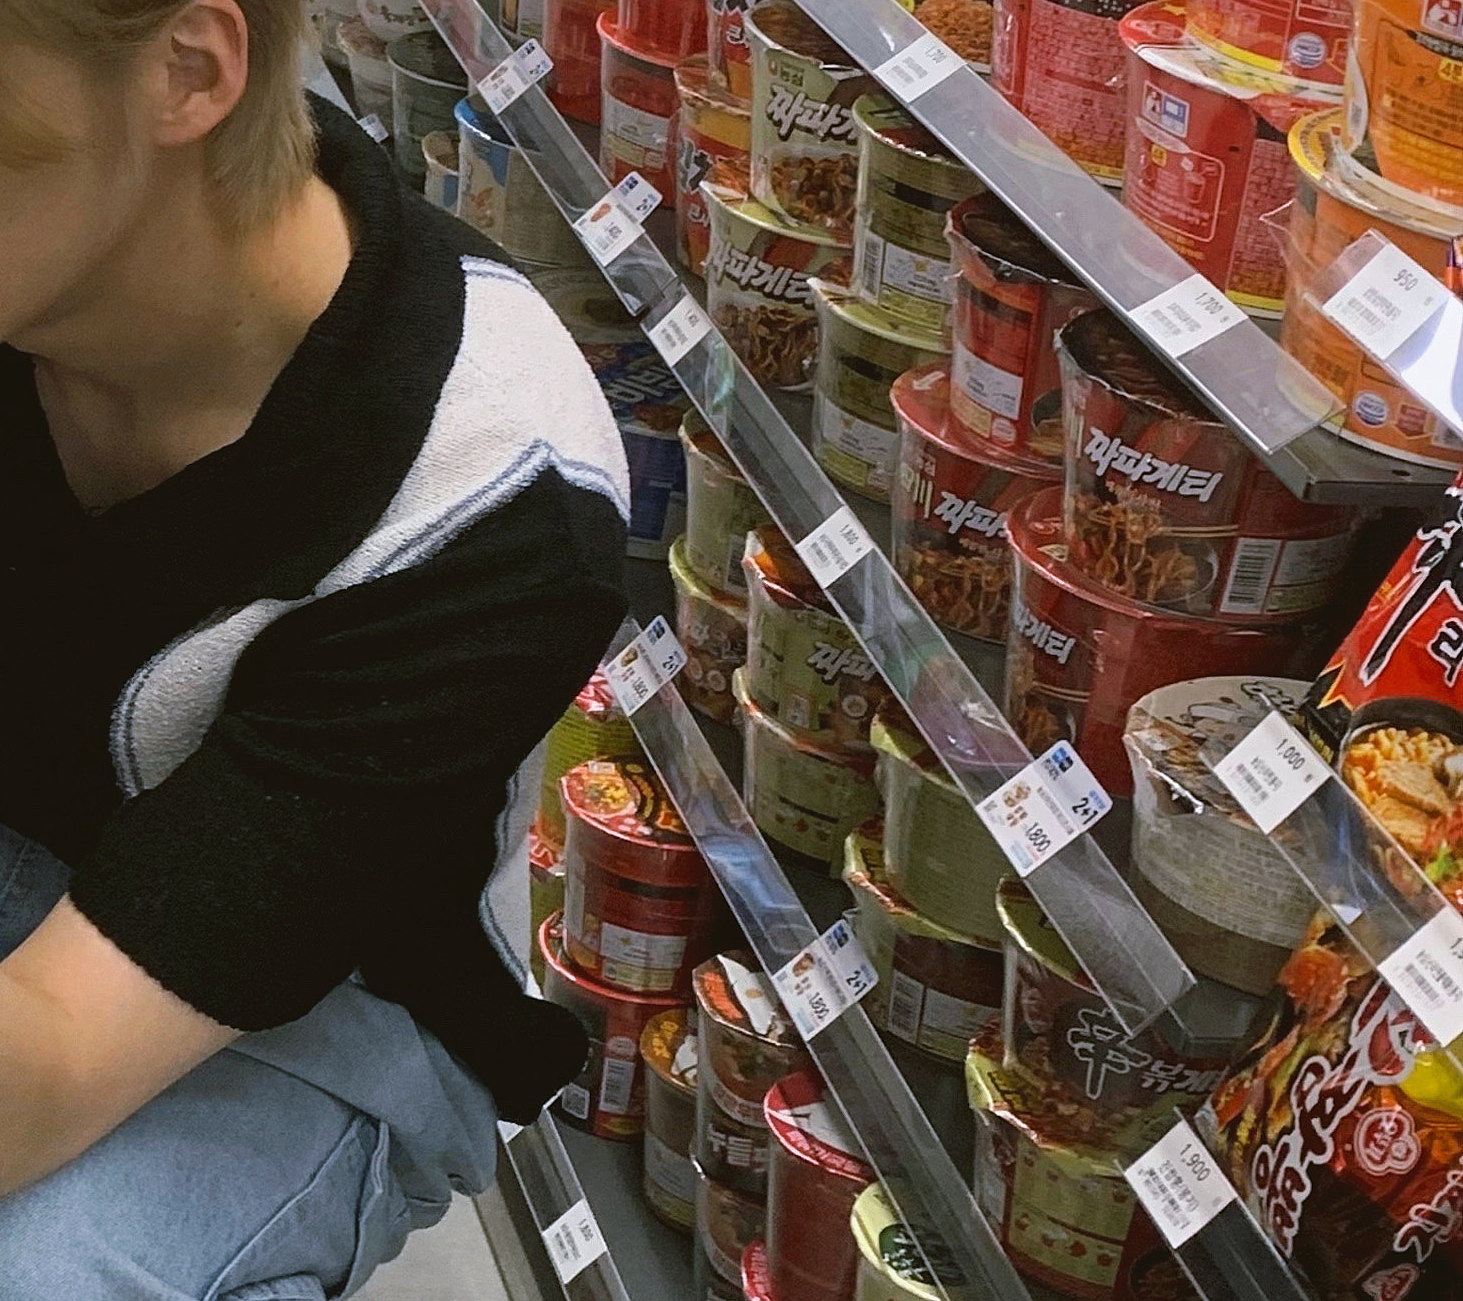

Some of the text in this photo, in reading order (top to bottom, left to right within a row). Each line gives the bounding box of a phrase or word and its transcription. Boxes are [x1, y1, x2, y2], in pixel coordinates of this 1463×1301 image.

[1392, 268, 1419, 293] 950
[1084, 427, 1224, 503] 짜파게티
[1274, 737, 1307, 773] 1,000
[1071, 794, 1099, 826] 2+1
[1023, 819, 1052, 854] 1,800
[845, 968, 867, 997] 2+1
[1178, 1142, 1213, 1184] 1,900
